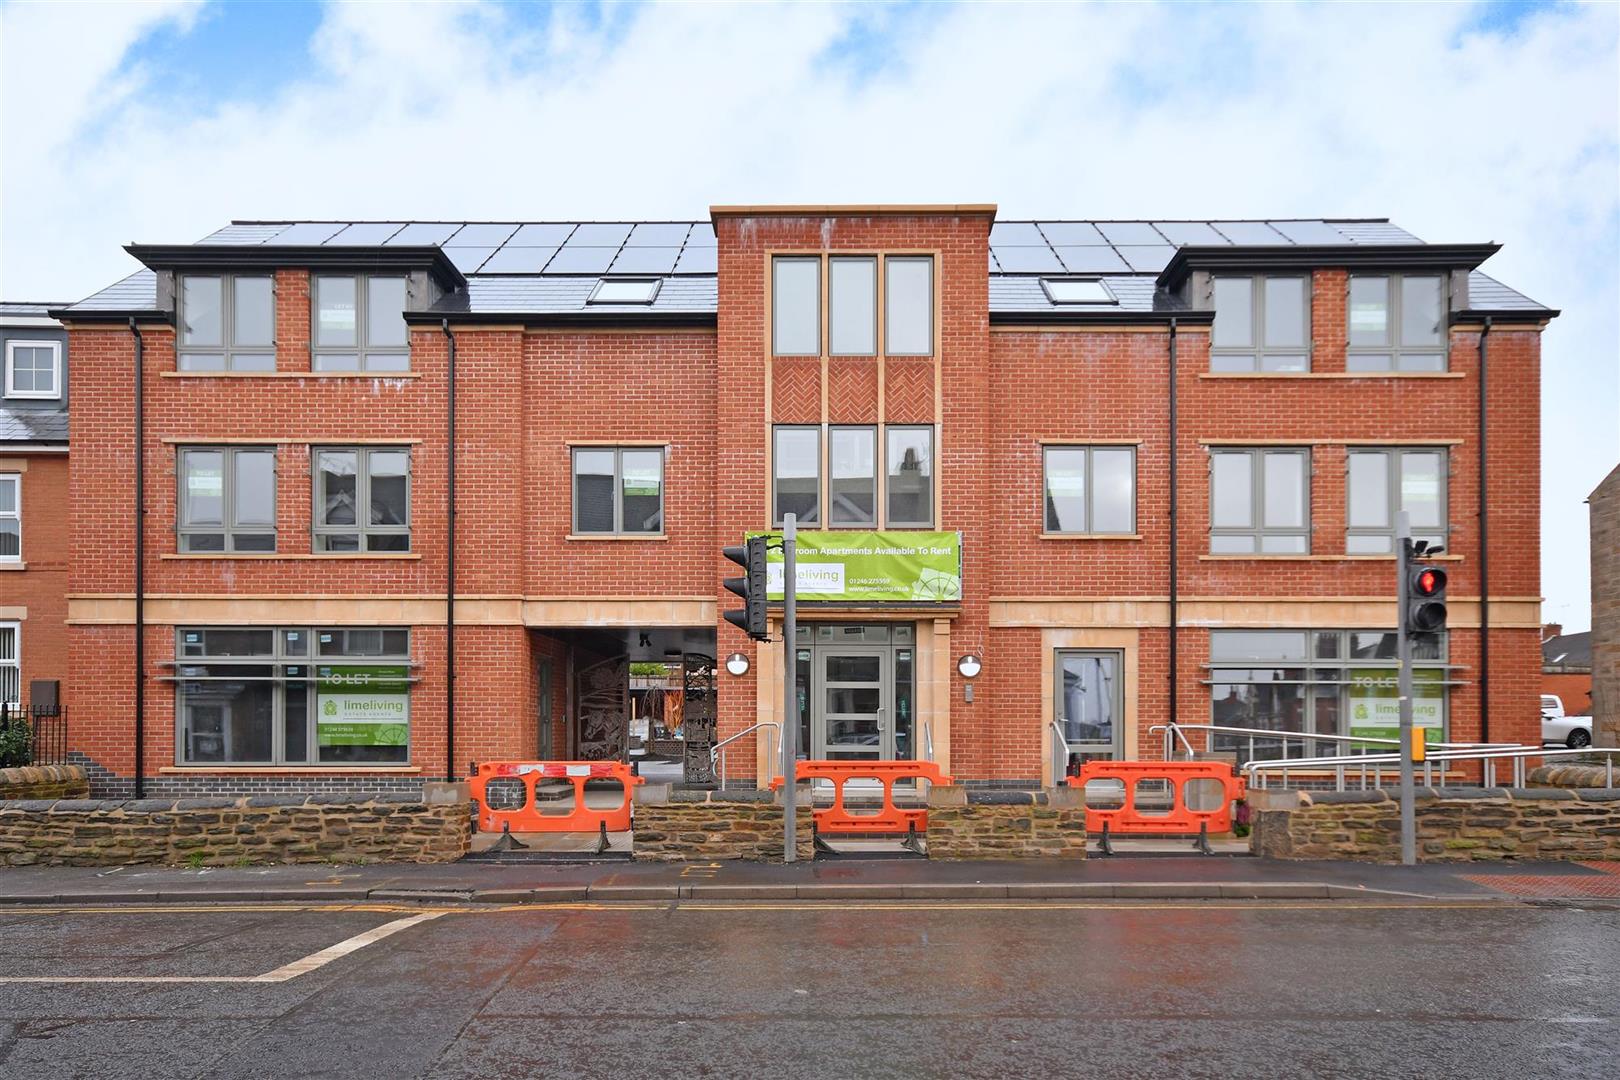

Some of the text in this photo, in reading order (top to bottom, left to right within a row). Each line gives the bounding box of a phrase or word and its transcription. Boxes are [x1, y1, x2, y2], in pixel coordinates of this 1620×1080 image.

[820, 547, 873, 556] Apartments
[875, 547, 916, 555] Available
[919, 547, 929, 555] To
[930, 547, 952, 555] Rent
[779, 568, 839, 582] leliving
[346, 673, 371, 685] LET
[1354, 677, 1374, 688] TO
[343, 700, 404, 713] limeliving
[1375, 703, 1436, 717] limeing
